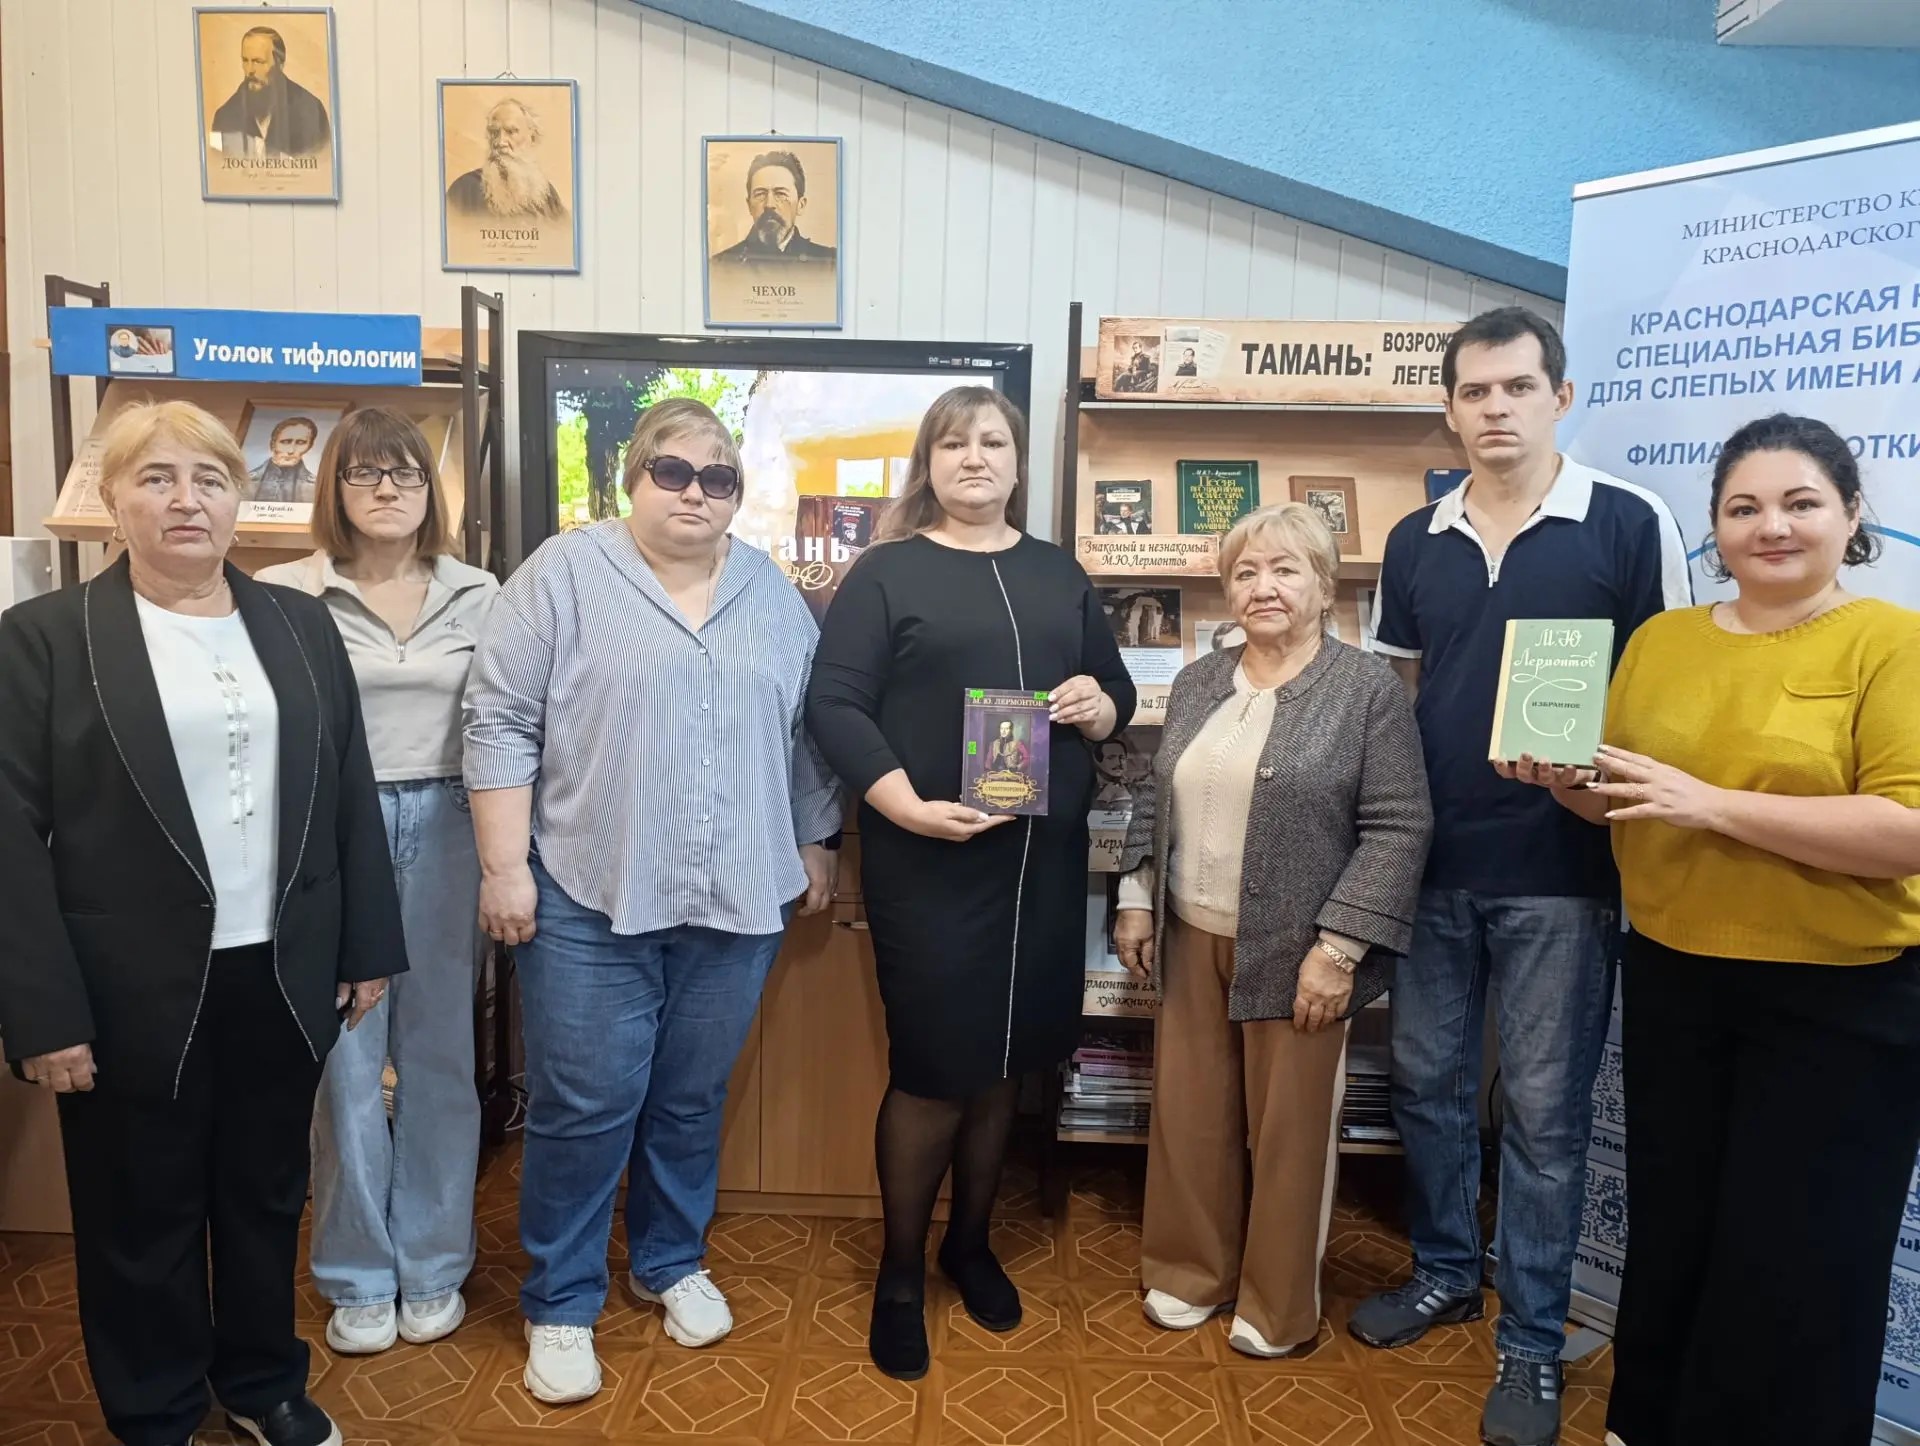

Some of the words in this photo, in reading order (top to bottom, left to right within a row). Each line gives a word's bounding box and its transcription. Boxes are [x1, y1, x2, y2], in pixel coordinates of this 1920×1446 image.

[221, 157, 319, 169] ДОСТОЕВСКИЙ
[1681, 193, 1892, 240] МИНИСТЕРСТВО
[1899, 188, 1920, 209] К
[479, 226, 540, 241] ТОЛСТОЙ
[751, 285, 796, 297] ЧЕХОВ
[1630, 285, 1900, 336] КРАСНОДАРСКАЯ
[193, 338, 274, 365] Уголок
[281, 341, 417, 373] тифлологии
[1616, 328, 1842, 370] СПЕЦИАЛЬНАЯ
[1241, 343, 1373, 376] ТАМАНЬ:
[1587, 379, 1642, 408] ДЛЯ
[1650, 368, 1778, 400] СЛЕПЫХ
[1786, 359, 1903, 392] ИМЕНИ
[1085, 541, 1137, 554] Знакомый
[1139, 544, 1146, 552] и
[1148, 542, 1209, 555] незнакомый
[1513, 647, 1598, 670] Лермонтов
[994, 698, 1044, 707] ЛЕРМОНТОВ
[1140, 699, 1154, 709] на
[1531, 701, 1581, 709] ИЗБРАННОЕ
[1592, 1134, 1626, 1153] che
